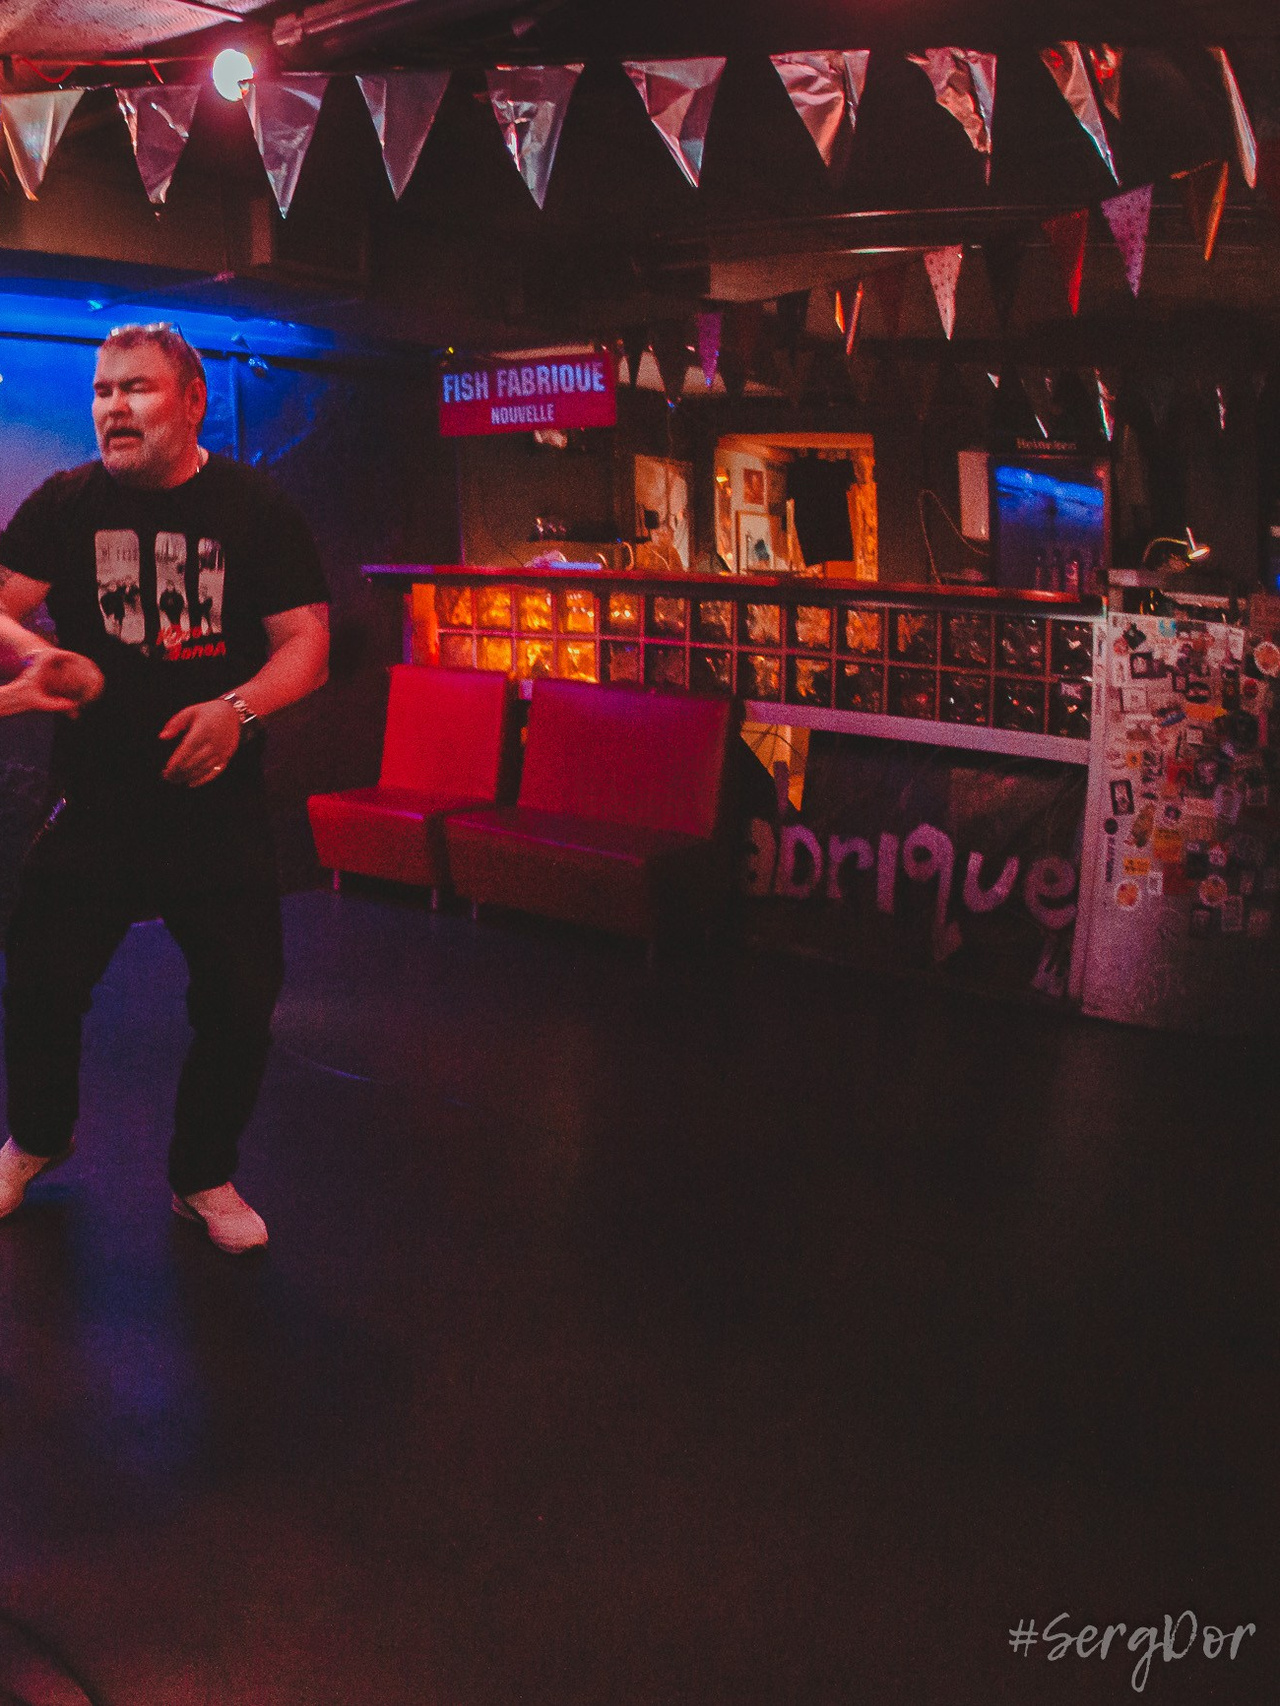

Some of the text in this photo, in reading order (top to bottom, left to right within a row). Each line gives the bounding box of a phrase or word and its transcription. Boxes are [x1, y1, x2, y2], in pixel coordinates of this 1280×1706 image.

[443, 362, 606, 403] FISH FABRIQUE
[492, 404, 555, 425] NOUVELLE
